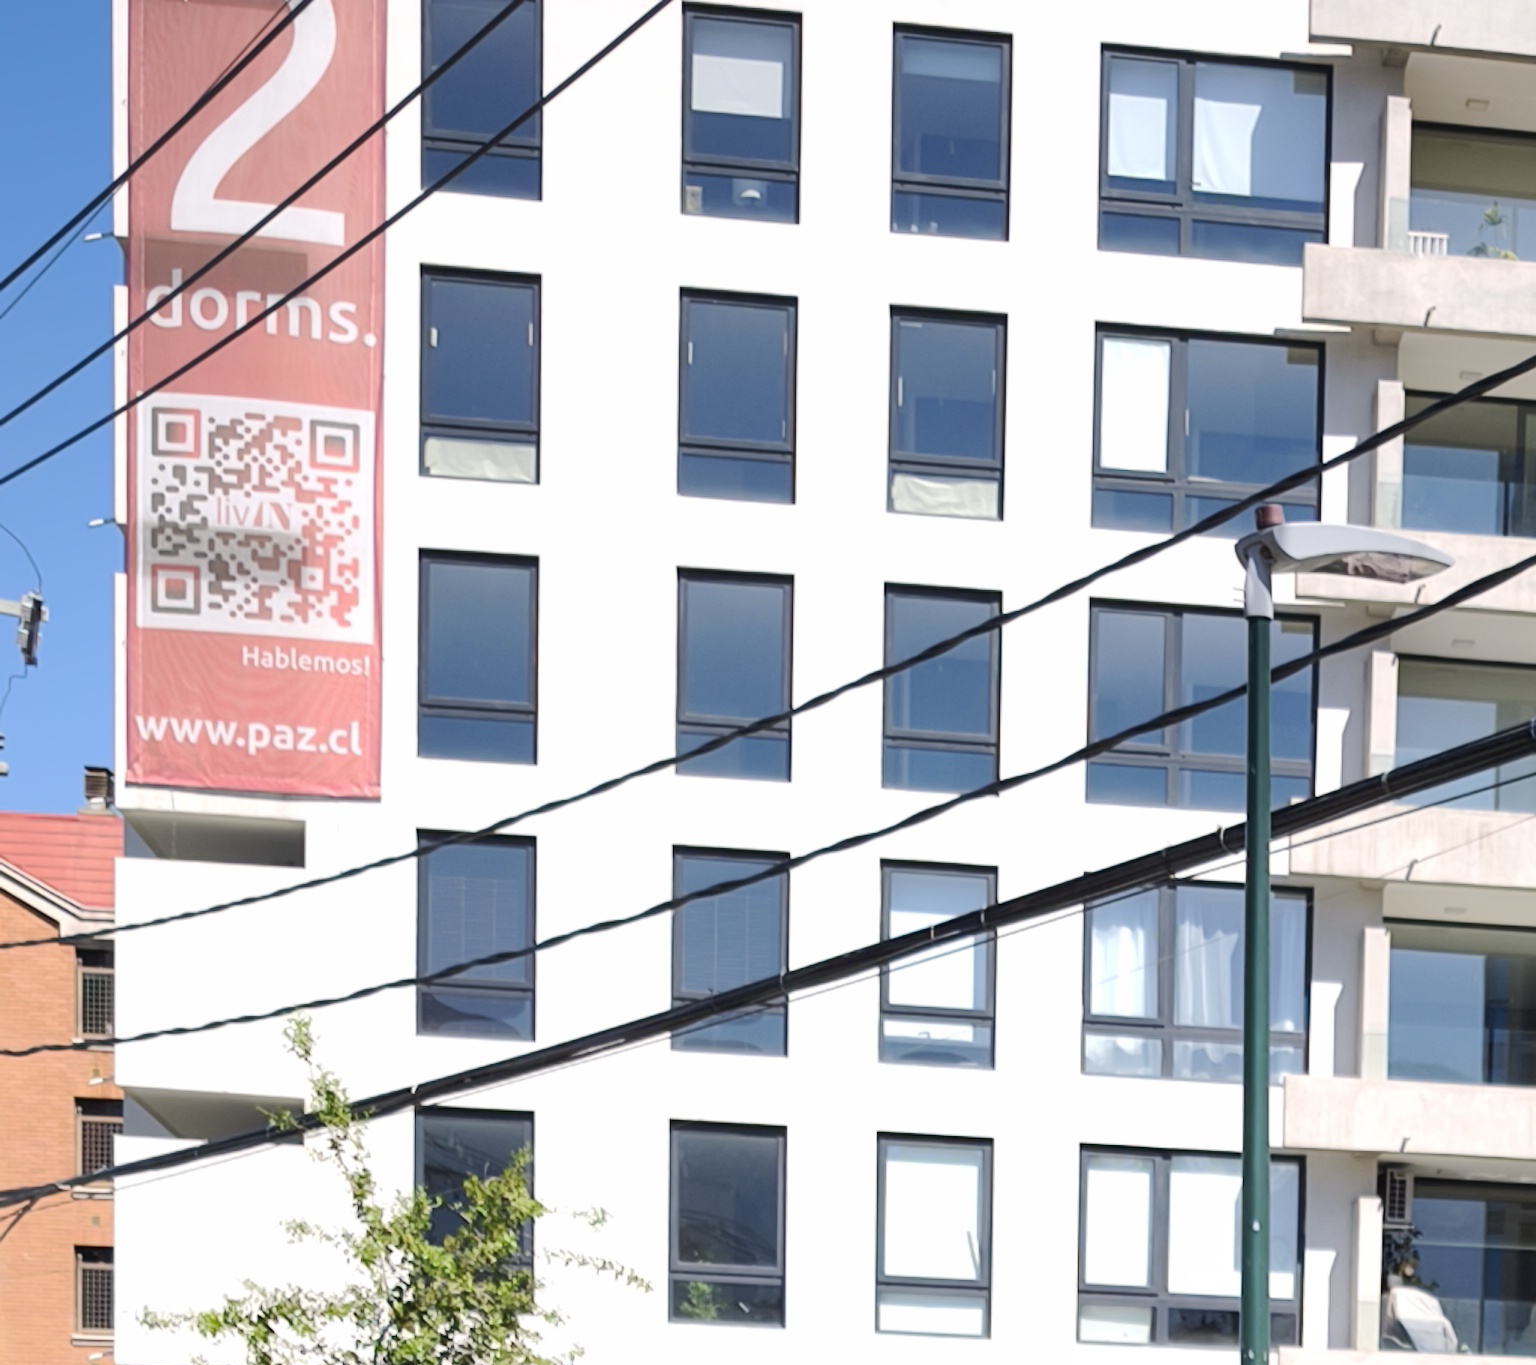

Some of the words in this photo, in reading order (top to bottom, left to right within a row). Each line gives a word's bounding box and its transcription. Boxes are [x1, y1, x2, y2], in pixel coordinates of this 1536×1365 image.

[170, 0, 344, 247] 2
[146, 268, 377, 348] dorms.
[242, 645, 371, 677] Hablemos!
[135, 714, 363, 756] www.paz.cl
